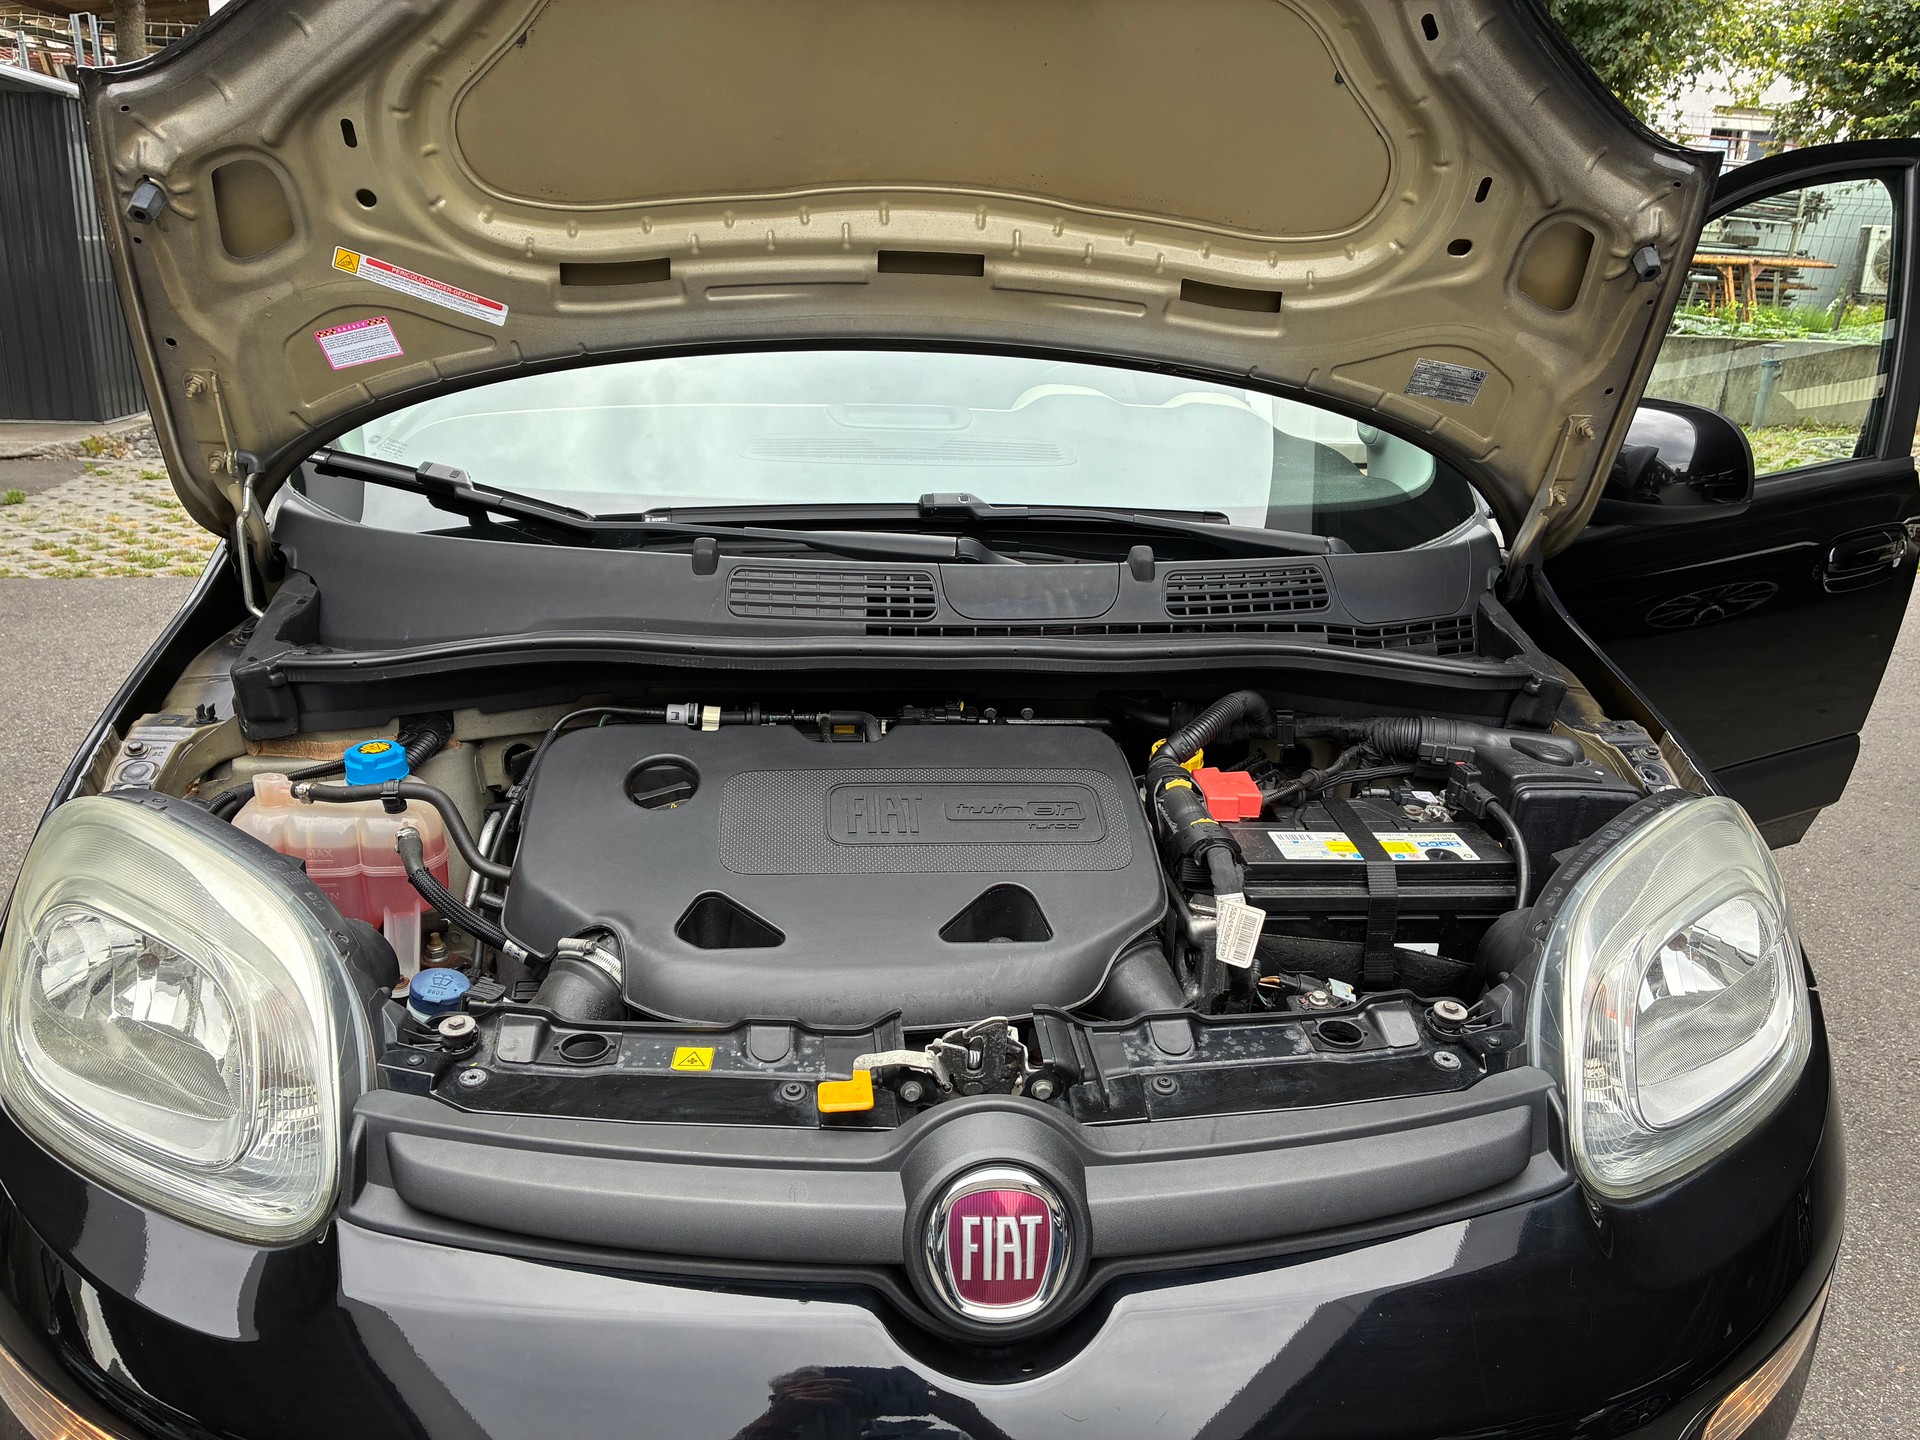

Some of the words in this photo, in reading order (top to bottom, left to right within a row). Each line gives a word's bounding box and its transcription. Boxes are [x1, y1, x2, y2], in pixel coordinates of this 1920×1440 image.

[846, 792, 923, 834] FIAT
[956, 803, 1023, 814] twin
[1034, 804, 1074, 816] air
[306, 849, 333, 858] MAX
[961, 1215, 1043, 1281] FIAT
